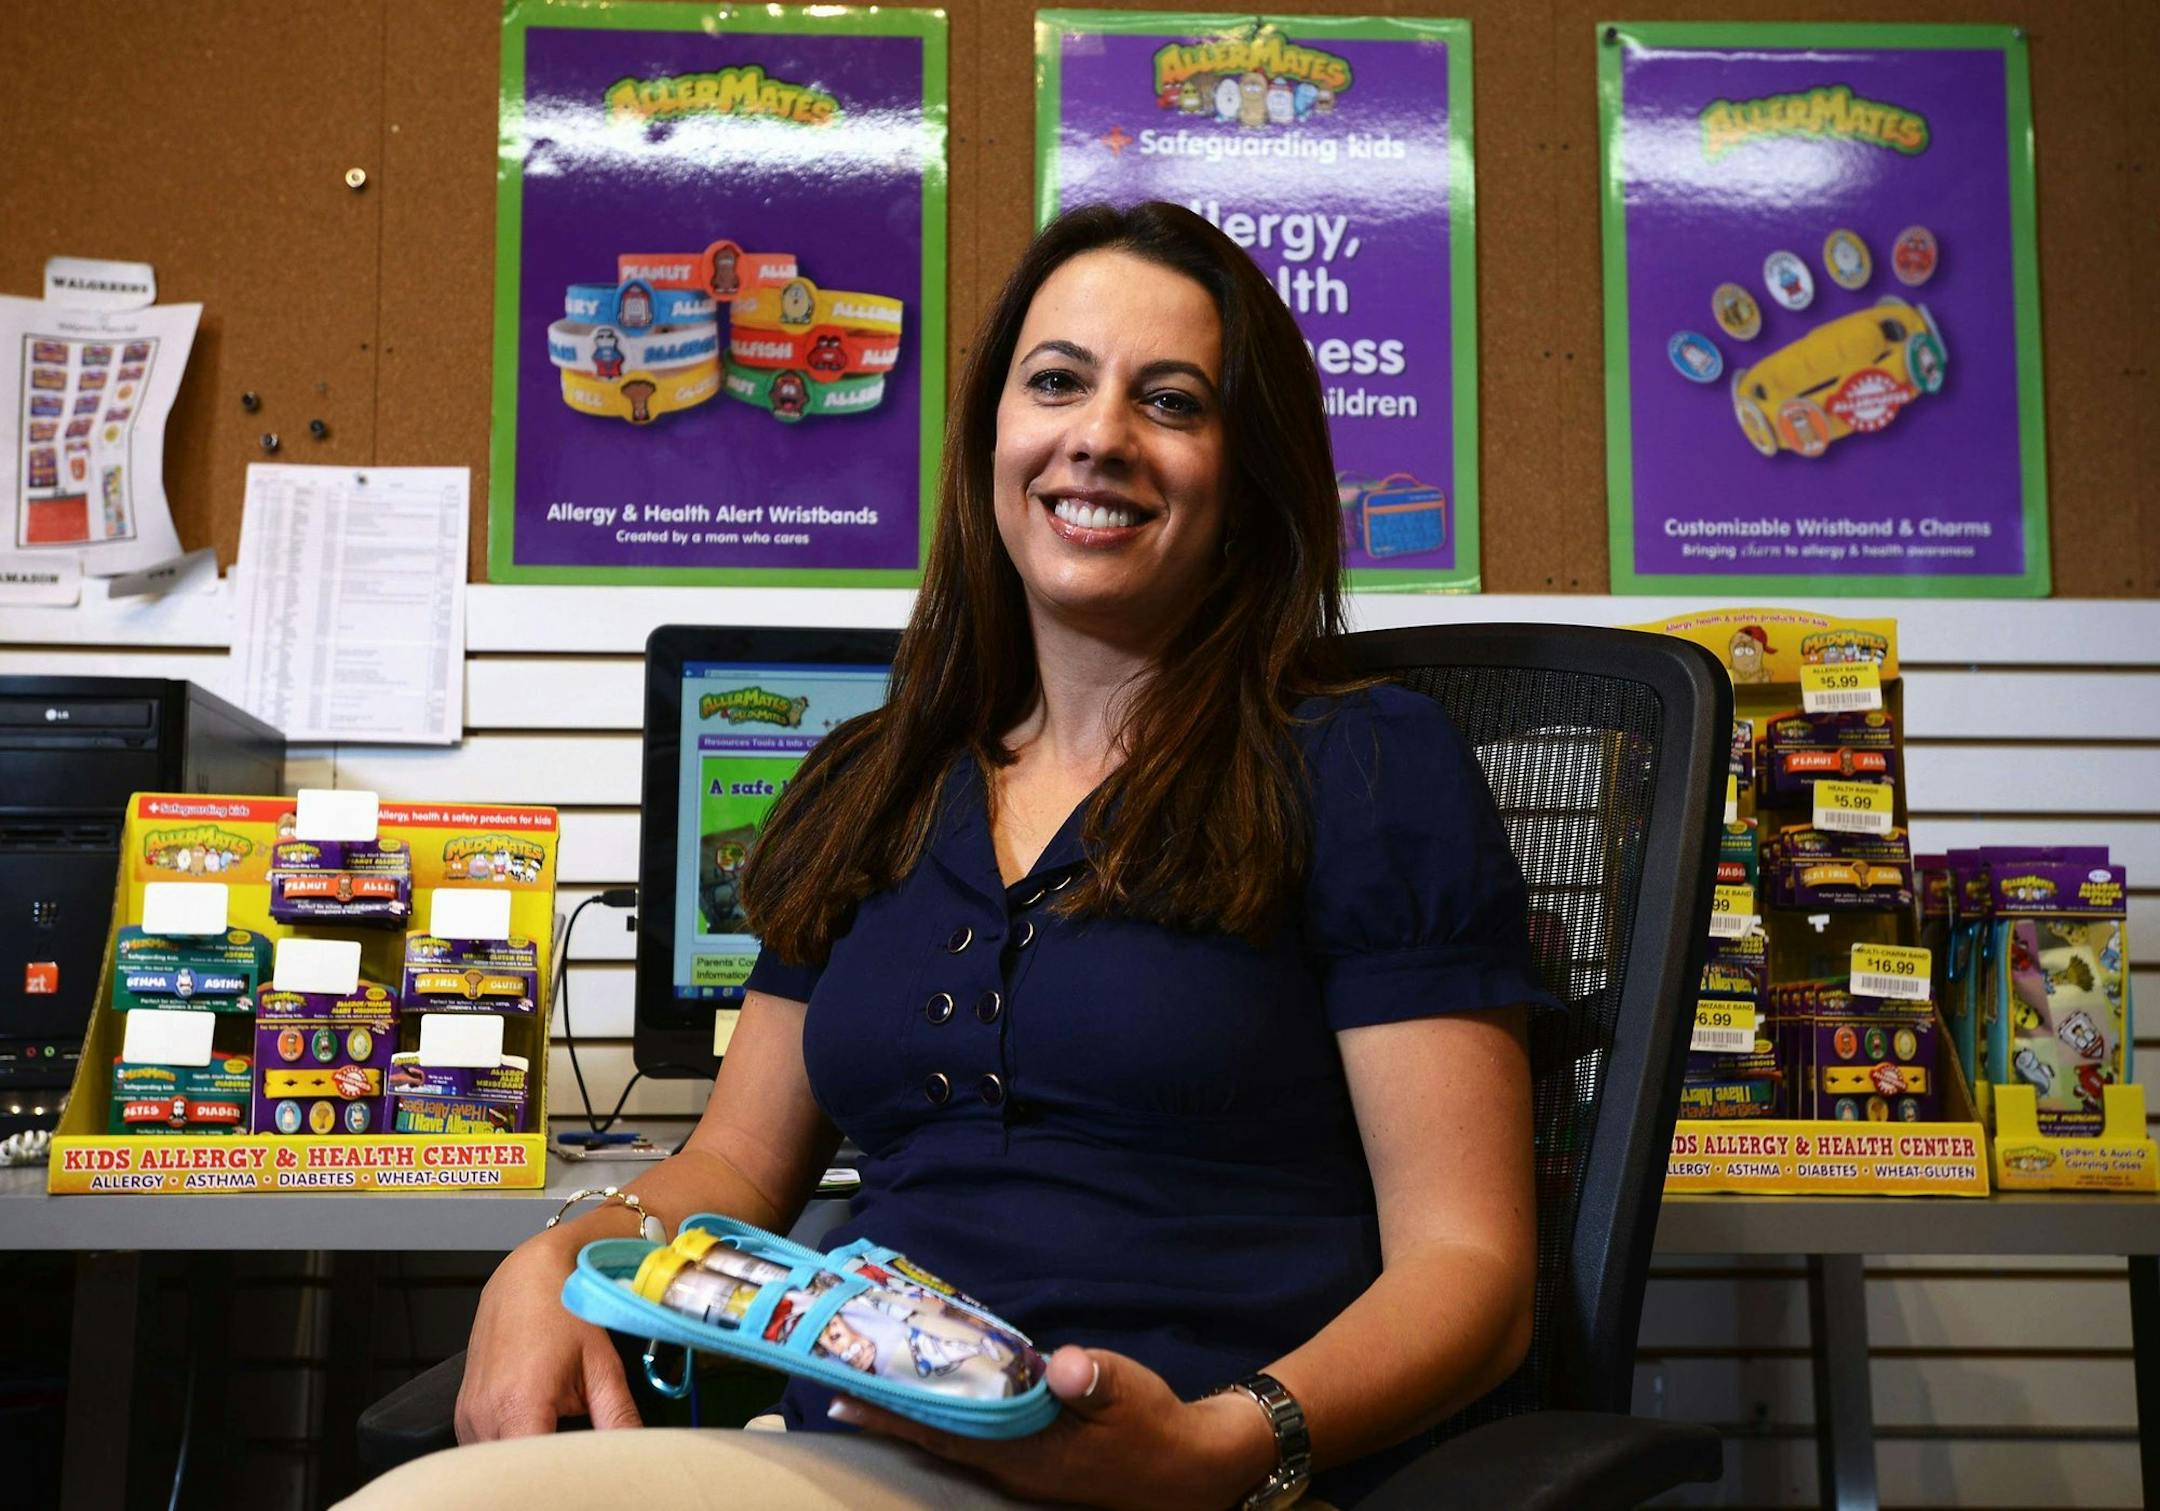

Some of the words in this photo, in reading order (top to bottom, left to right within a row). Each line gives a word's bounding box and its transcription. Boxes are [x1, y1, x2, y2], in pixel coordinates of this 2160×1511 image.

[1160, 38, 1347, 90] ALLERMATES
[1705, 88, 1923, 155] ALLERMATES
[1138, 129, 1338, 162] Safeguarding
[1348, 133, 1407, 160] kids
[1189, 200, 1361, 263] lergy,
[1268, 265, 1349, 315] lth
[1303, 338, 1406, 375] ess
[1322, 387, 1418, 418] ildren
[547, 503, 617, 526] Allergy
[622, 503, 638, 522] &
[645, 504, 710, 523] Health
[716, 504, 764, 524] Alert
[768, 506, 879, 525] Wristbands
[1664, 517, 1792, 538] Customizable
[1795, 517, 1894, 538] Wristband
[1899, 518, 1914, 537] &
[1918, 518, 1992, 539] Charms
[616, 529, 669, 544] Created
[672, 530, 688, 546] by
[691, 532, 701, 544] a
[705, 533, 738, 545] mom
[741, 531, 770, 545] who
[773, 533, 810, 545] cares
[1682, 543, 1737, 560] Bringing
[1784, 545, 1799, 558] to
[1801, 543, 1847, 560] allergy
[1849, 545, 1860, 558] &
[1861, 544, 1905, 558] health
[1821, 675, 1859, 690] $5.99
[704, 738, 750, 747] Resources
[752, 738, 775, 748] Tools
[710, 778, 723, 794] A
[731, 778, 774, 795] safe
[1834, 794, 1872, 810] $5.99
[412, 810, 440, 822] health
[442, 811, 449, 822] &
[451, 812, 477, 825] safety
[480, 813, 517, 826] products
[519, 815, 532, 824] for
[534, 814, 552, 825] kids
[285, 881, 328, 892] PEANUT
[696, 956, 737, 967] Parents'
[1867, 959, 1915, 975] $16.99
[1671, 1135, 1698, 1155] DS
[1704, 1136, 1788, 1155] ALLERGY
[1795, 1136, 1811, 1155] &
[1817, 1137, 1895, 1156] HEALTH
[1899, 1137, 1976, 1157] CENTER
[64, 1149, 131, 1170] KIDS
[139, 1148, 268, 1170] ALLERGY
[275, 1148, 297, 1168] &
[308, 1147, 414, 1167] HEALTH
[423, 1145, 526, 1166] CENTER
[2065, 1160, 2109, 1170] Carrying
[91, 1174, 164, 1189] ALLERGY
[185, 1173, 256, 1188] ASTHMA
[279, 1172, 354, 1186] DIABETES
[377, 1170, 500, 1184] WHEAT-GLUTEN
[1727, 1164, 1780, 1176] ASTHMA
[1797, 1164, 1858, 1177] DIABETES
[1875, 1165, 1976, 1179] WHEAT-GLUTEN
